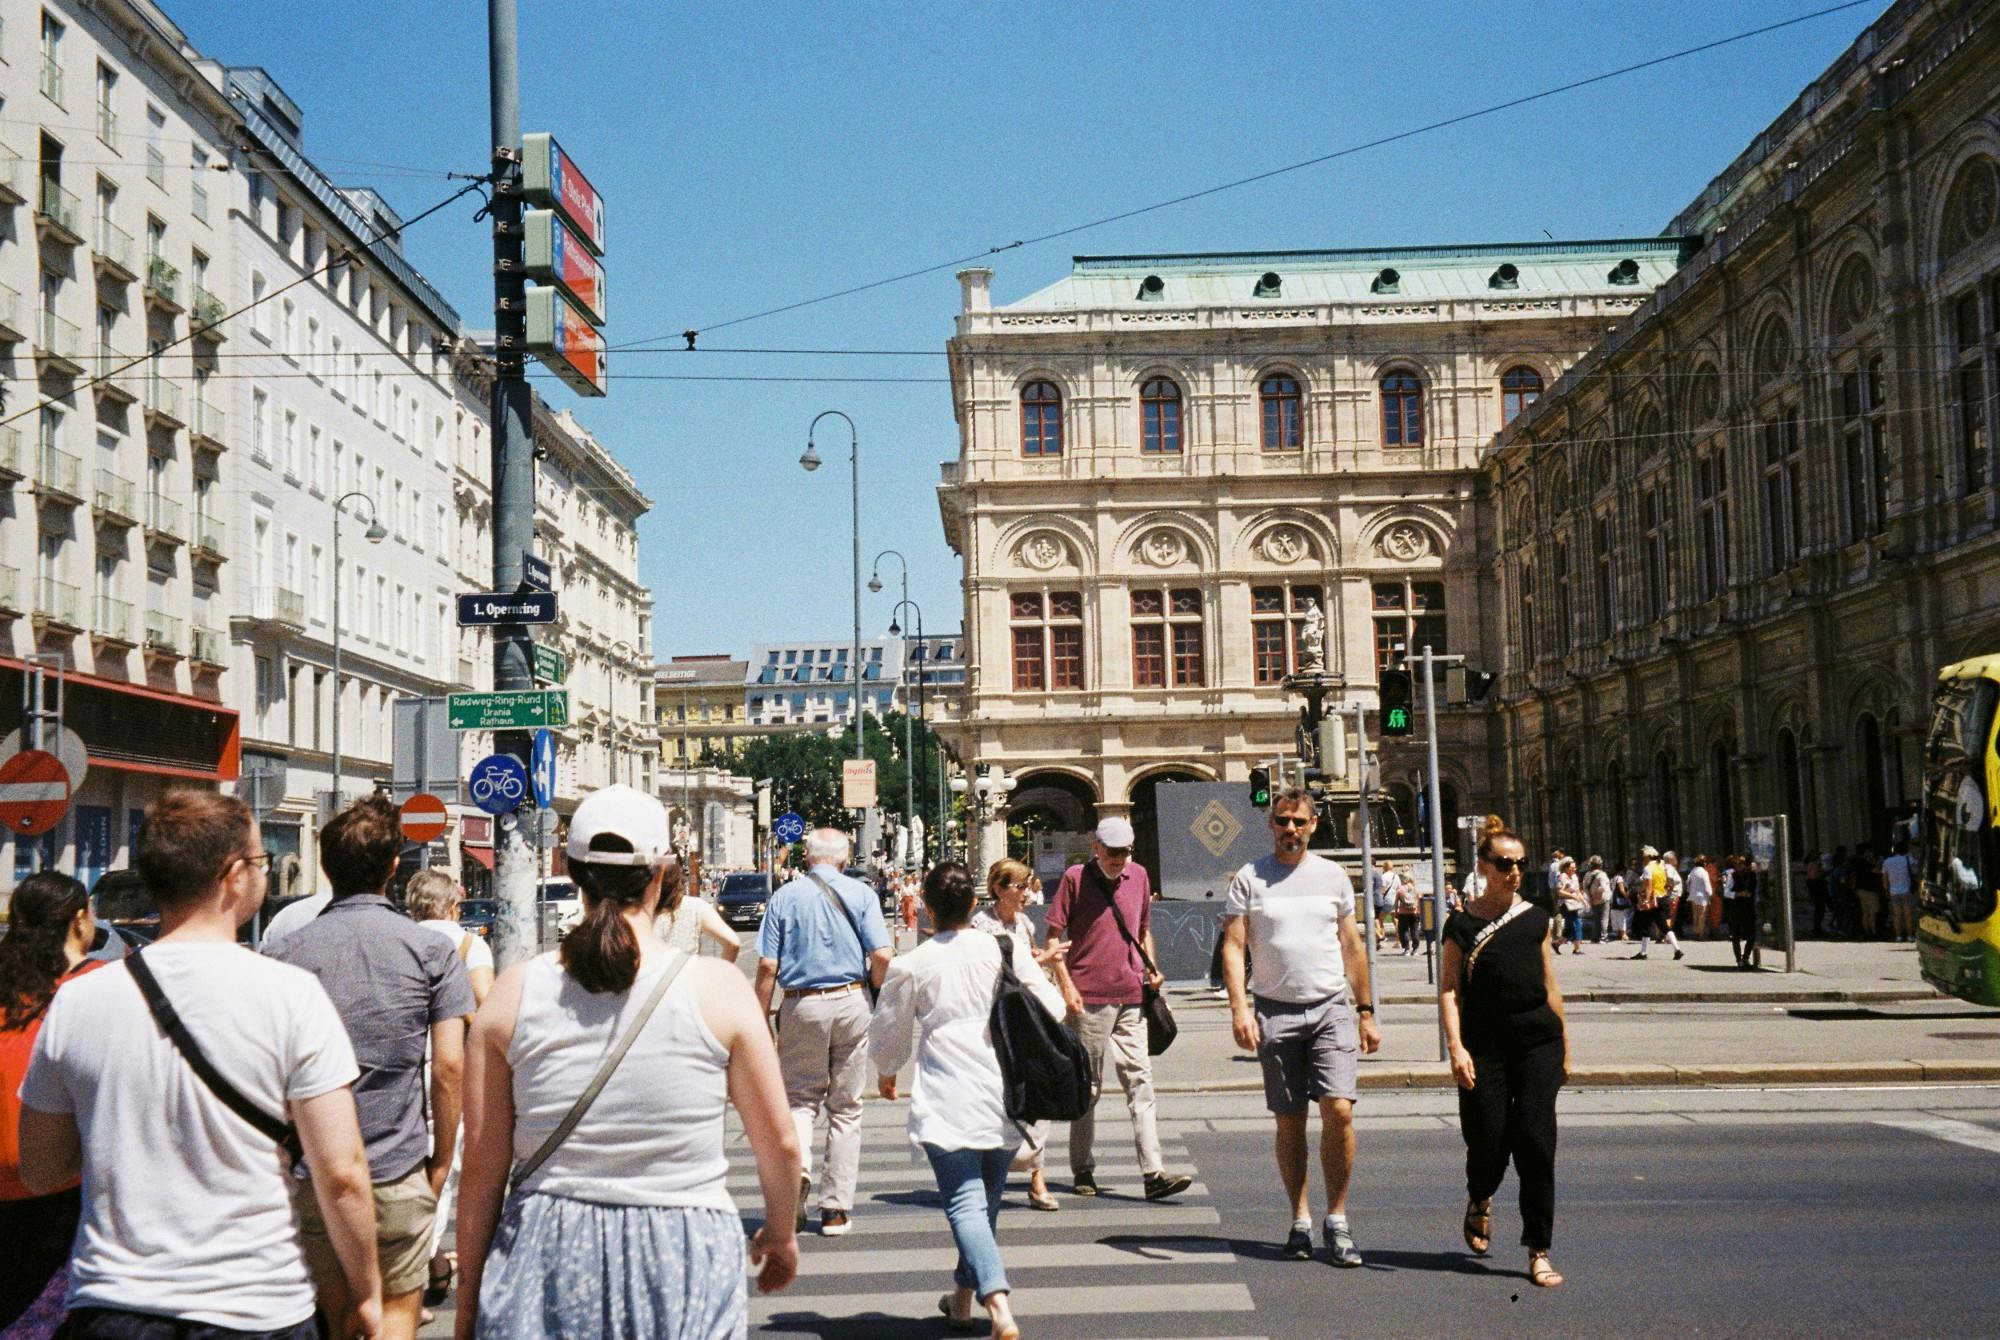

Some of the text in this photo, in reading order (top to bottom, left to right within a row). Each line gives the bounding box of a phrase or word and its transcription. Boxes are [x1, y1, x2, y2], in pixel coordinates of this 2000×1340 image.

[486, 602, 540, 619] Opernring
[453, 695, 541, 707] Radweg-Ring-Rund
[483, 708, 511, 717] Urania
[480, 717, 515, 726] Rathaus
